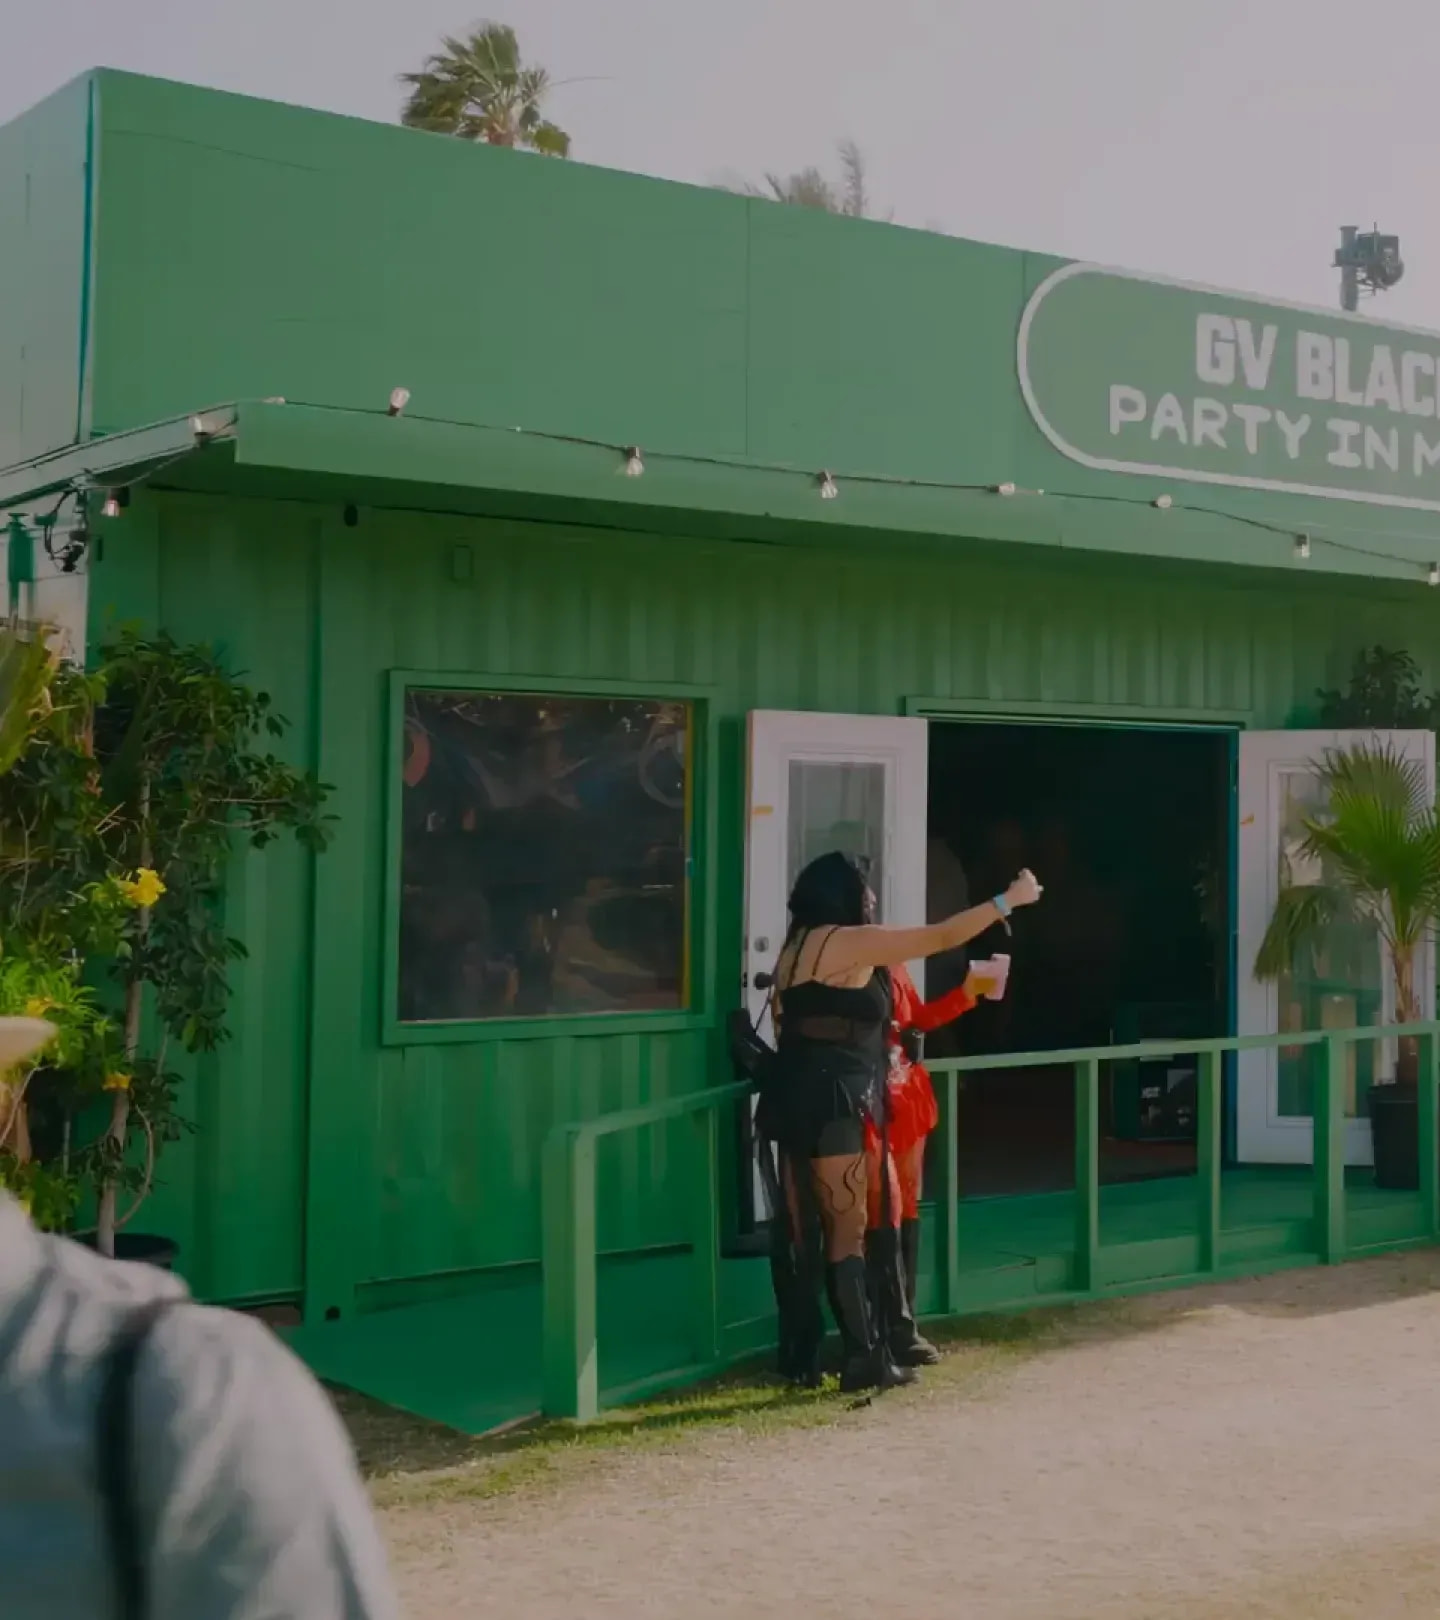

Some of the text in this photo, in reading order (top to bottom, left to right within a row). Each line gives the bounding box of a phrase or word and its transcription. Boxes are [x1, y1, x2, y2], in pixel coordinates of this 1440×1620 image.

[1196, 313, 1278, 390] GV
[1109, 385, 1310, 459] PARTY
[1326, 416, 1400, 472] IN
